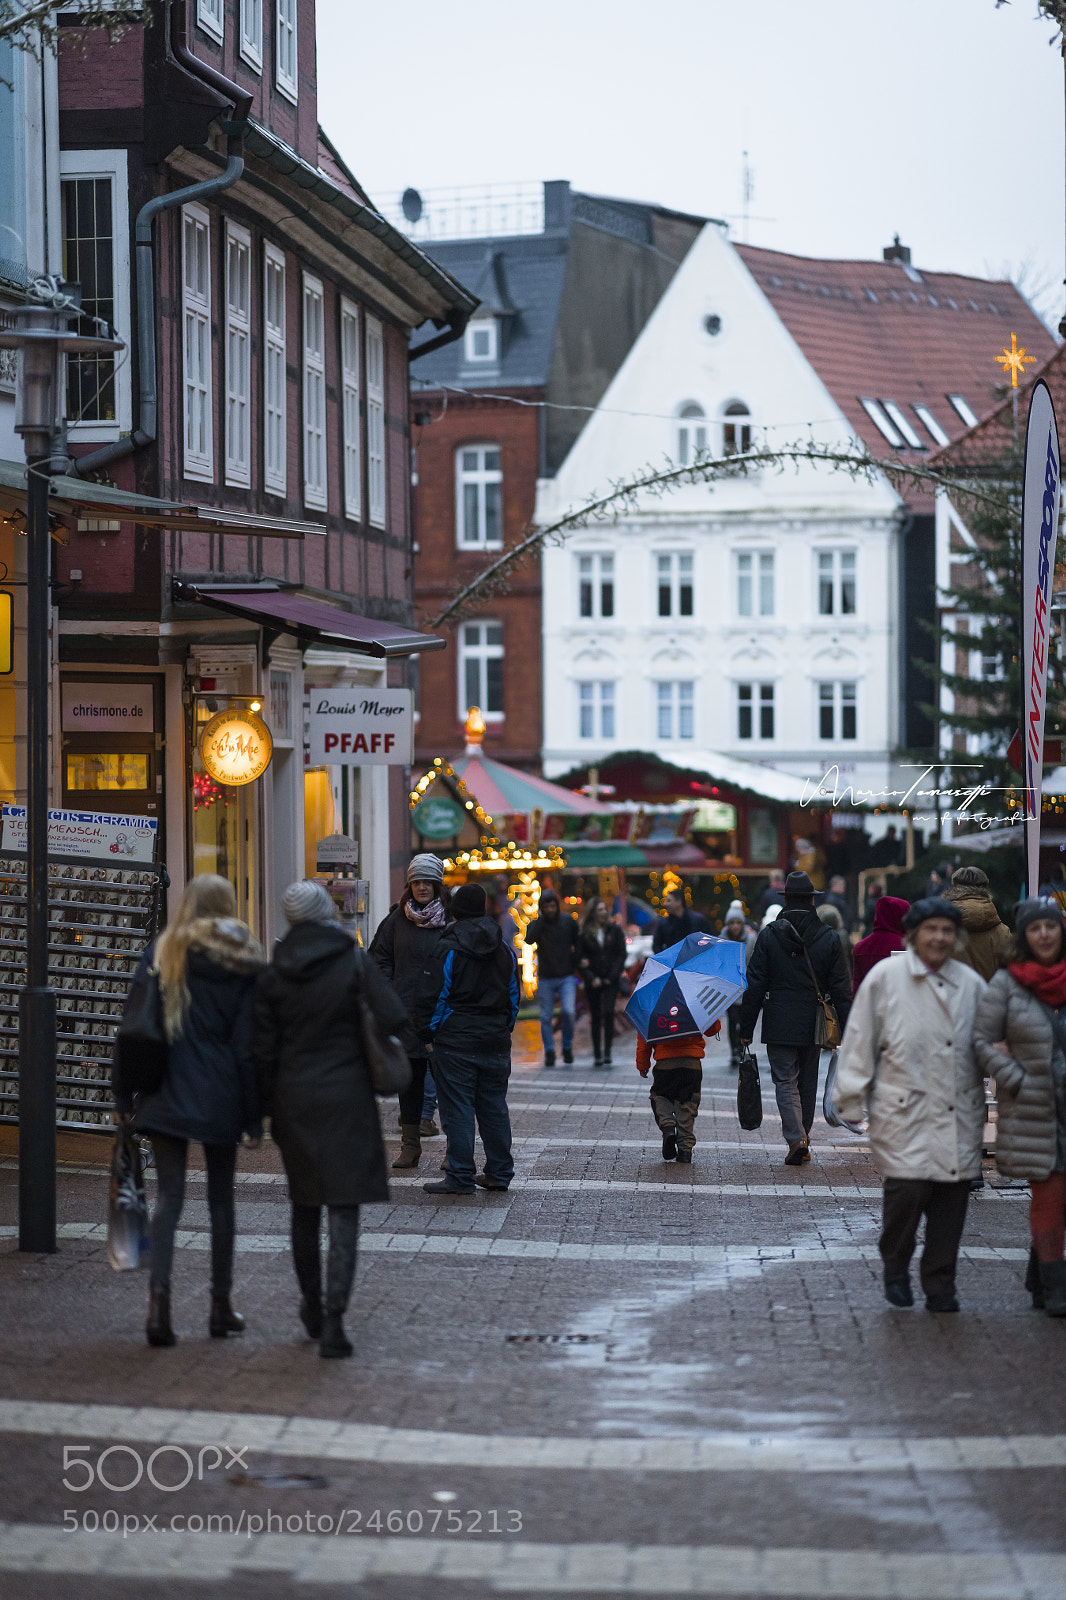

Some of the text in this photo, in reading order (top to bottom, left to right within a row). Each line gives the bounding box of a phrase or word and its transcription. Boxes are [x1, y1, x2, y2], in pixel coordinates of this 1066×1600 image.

[1028, 429, 1058, 765] INTERSPORT
[72, 703, 144, 717] chrismone.de
[316, 700, 405, 717] Louis Meyer
[324, 733, 395, 753] PFAFF
